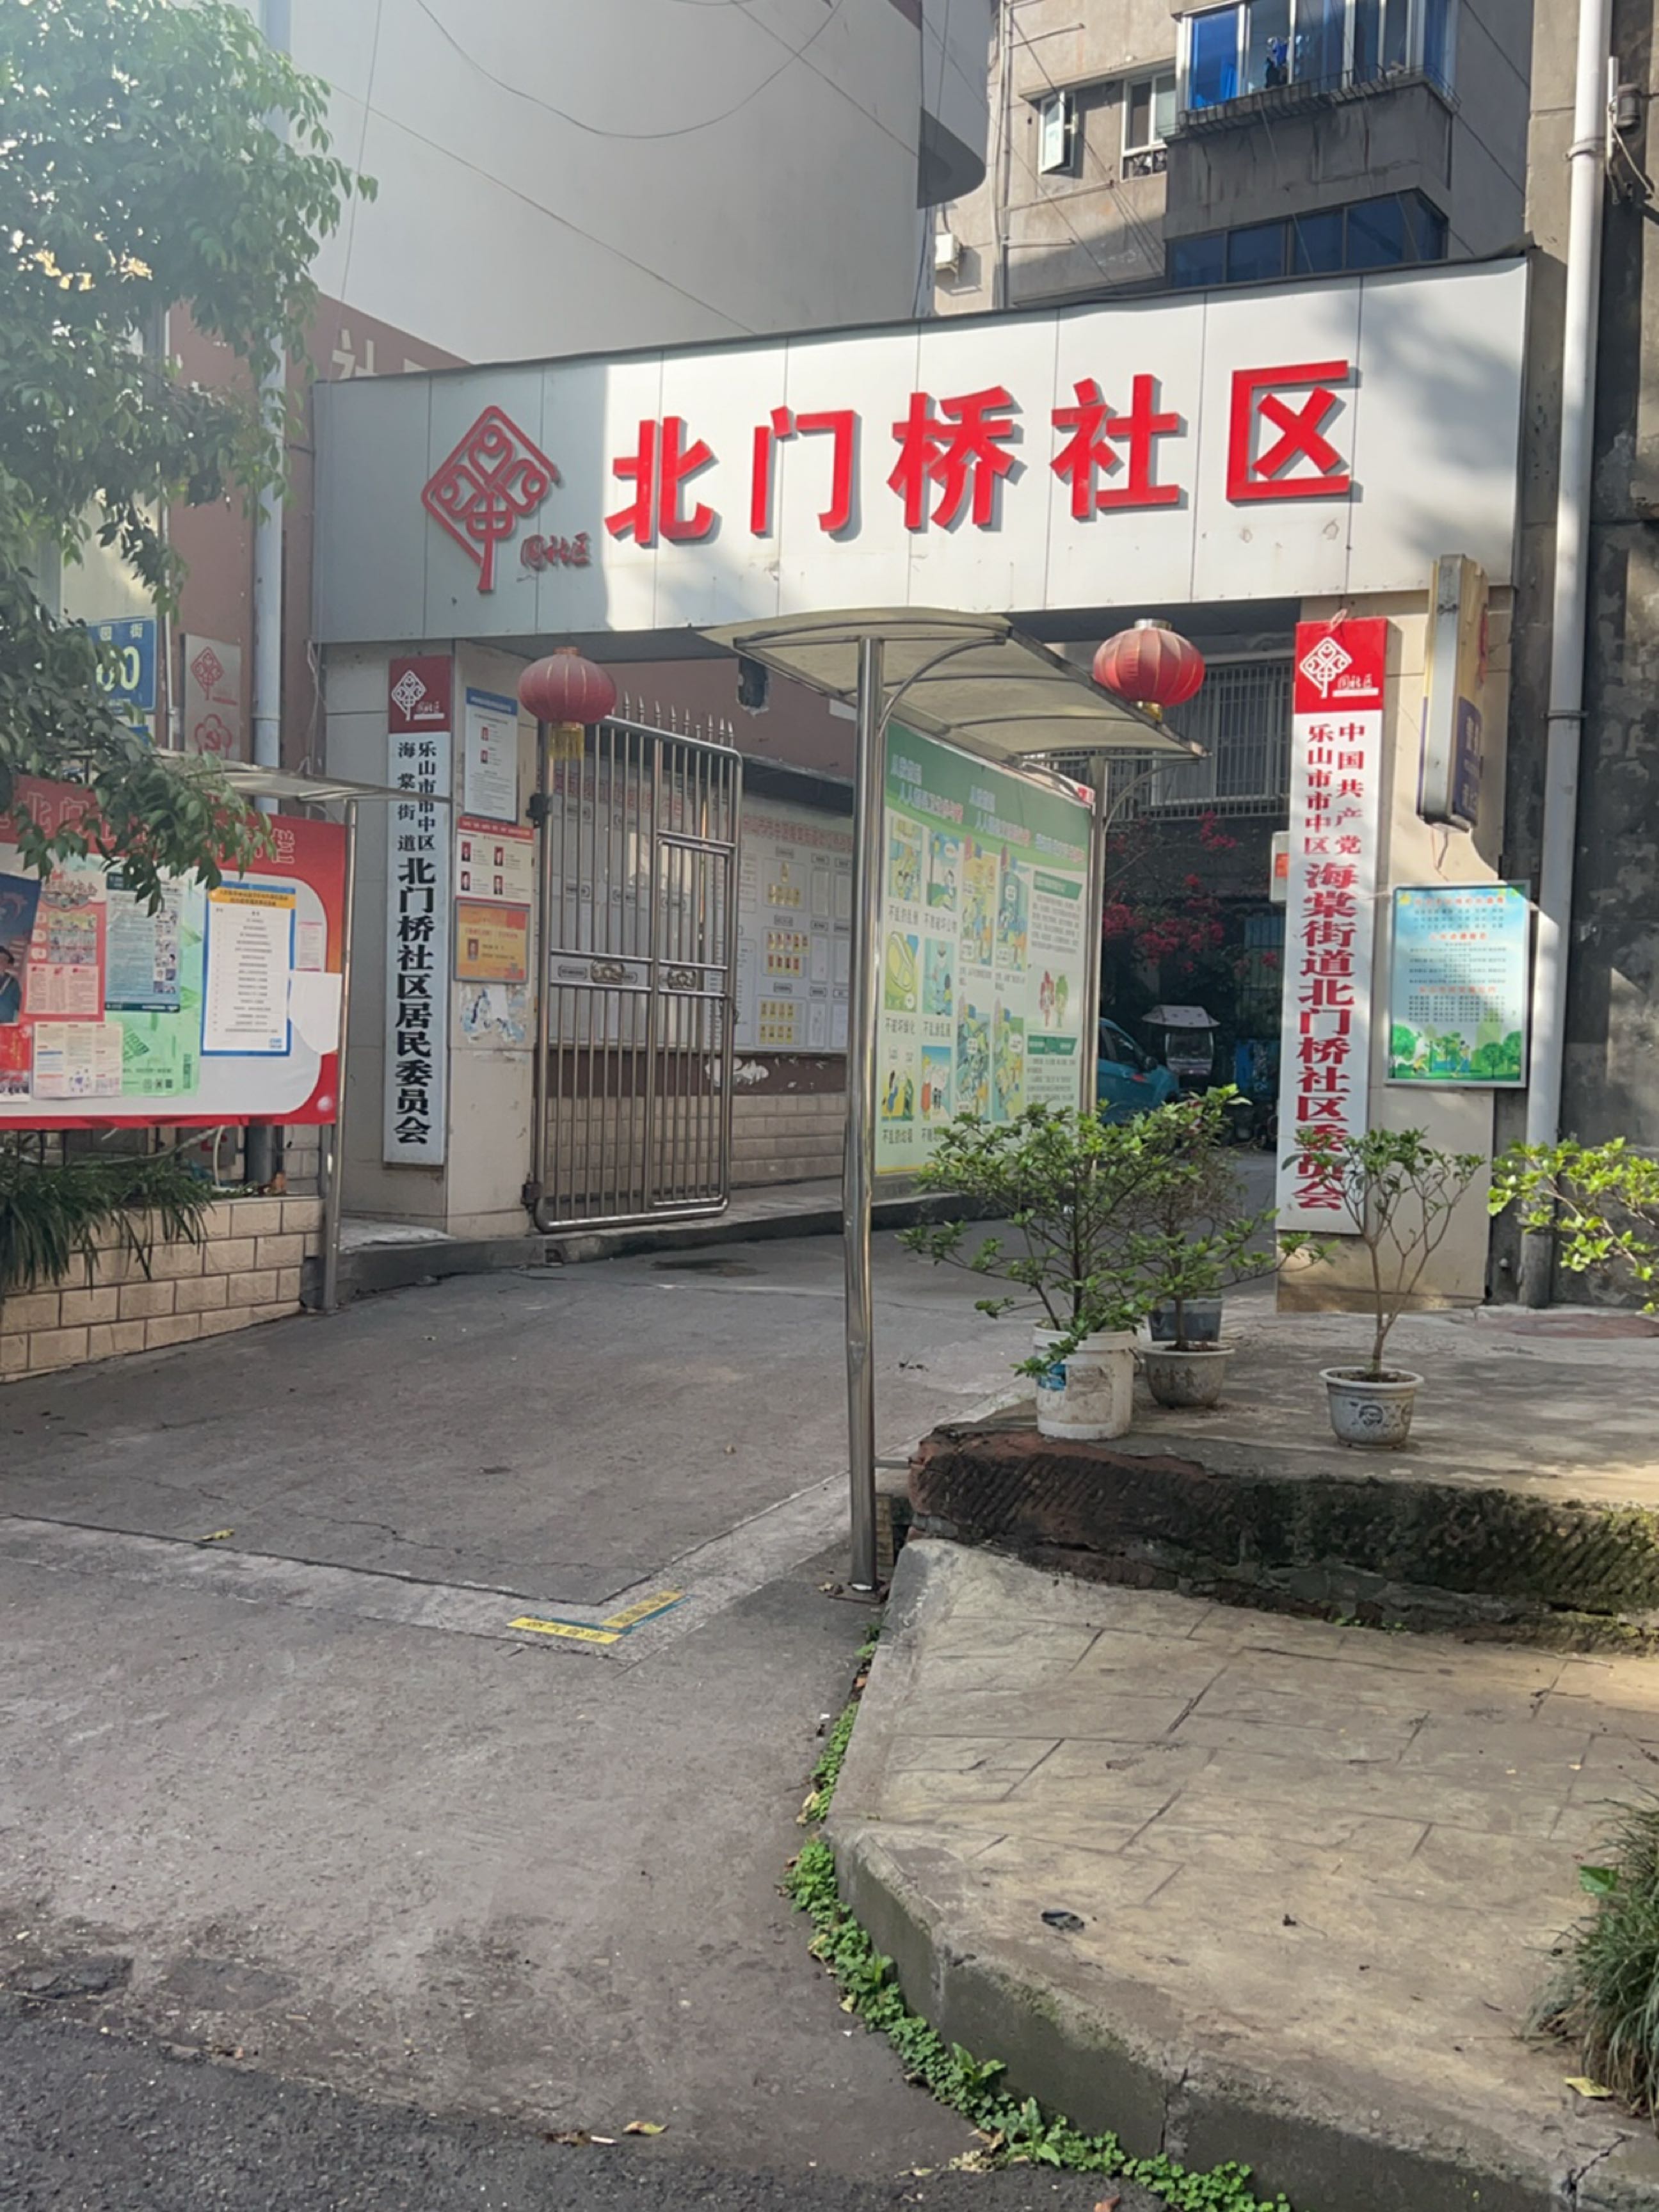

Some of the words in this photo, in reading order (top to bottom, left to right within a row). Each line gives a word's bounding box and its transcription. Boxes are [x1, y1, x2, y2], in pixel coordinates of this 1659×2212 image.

[605, 359, 1350, 544] 北门桥社区
[397, 741, 415, 851] 海棠街道
[418, 741, 437, 851] 乐山市市中区
[1304, 723, 1334, 856] 乐山市市中区
[1334, 722, 1366, 855] 中国共产党
[393, 857, 437, 1145] 北门桥社区居民委员会
